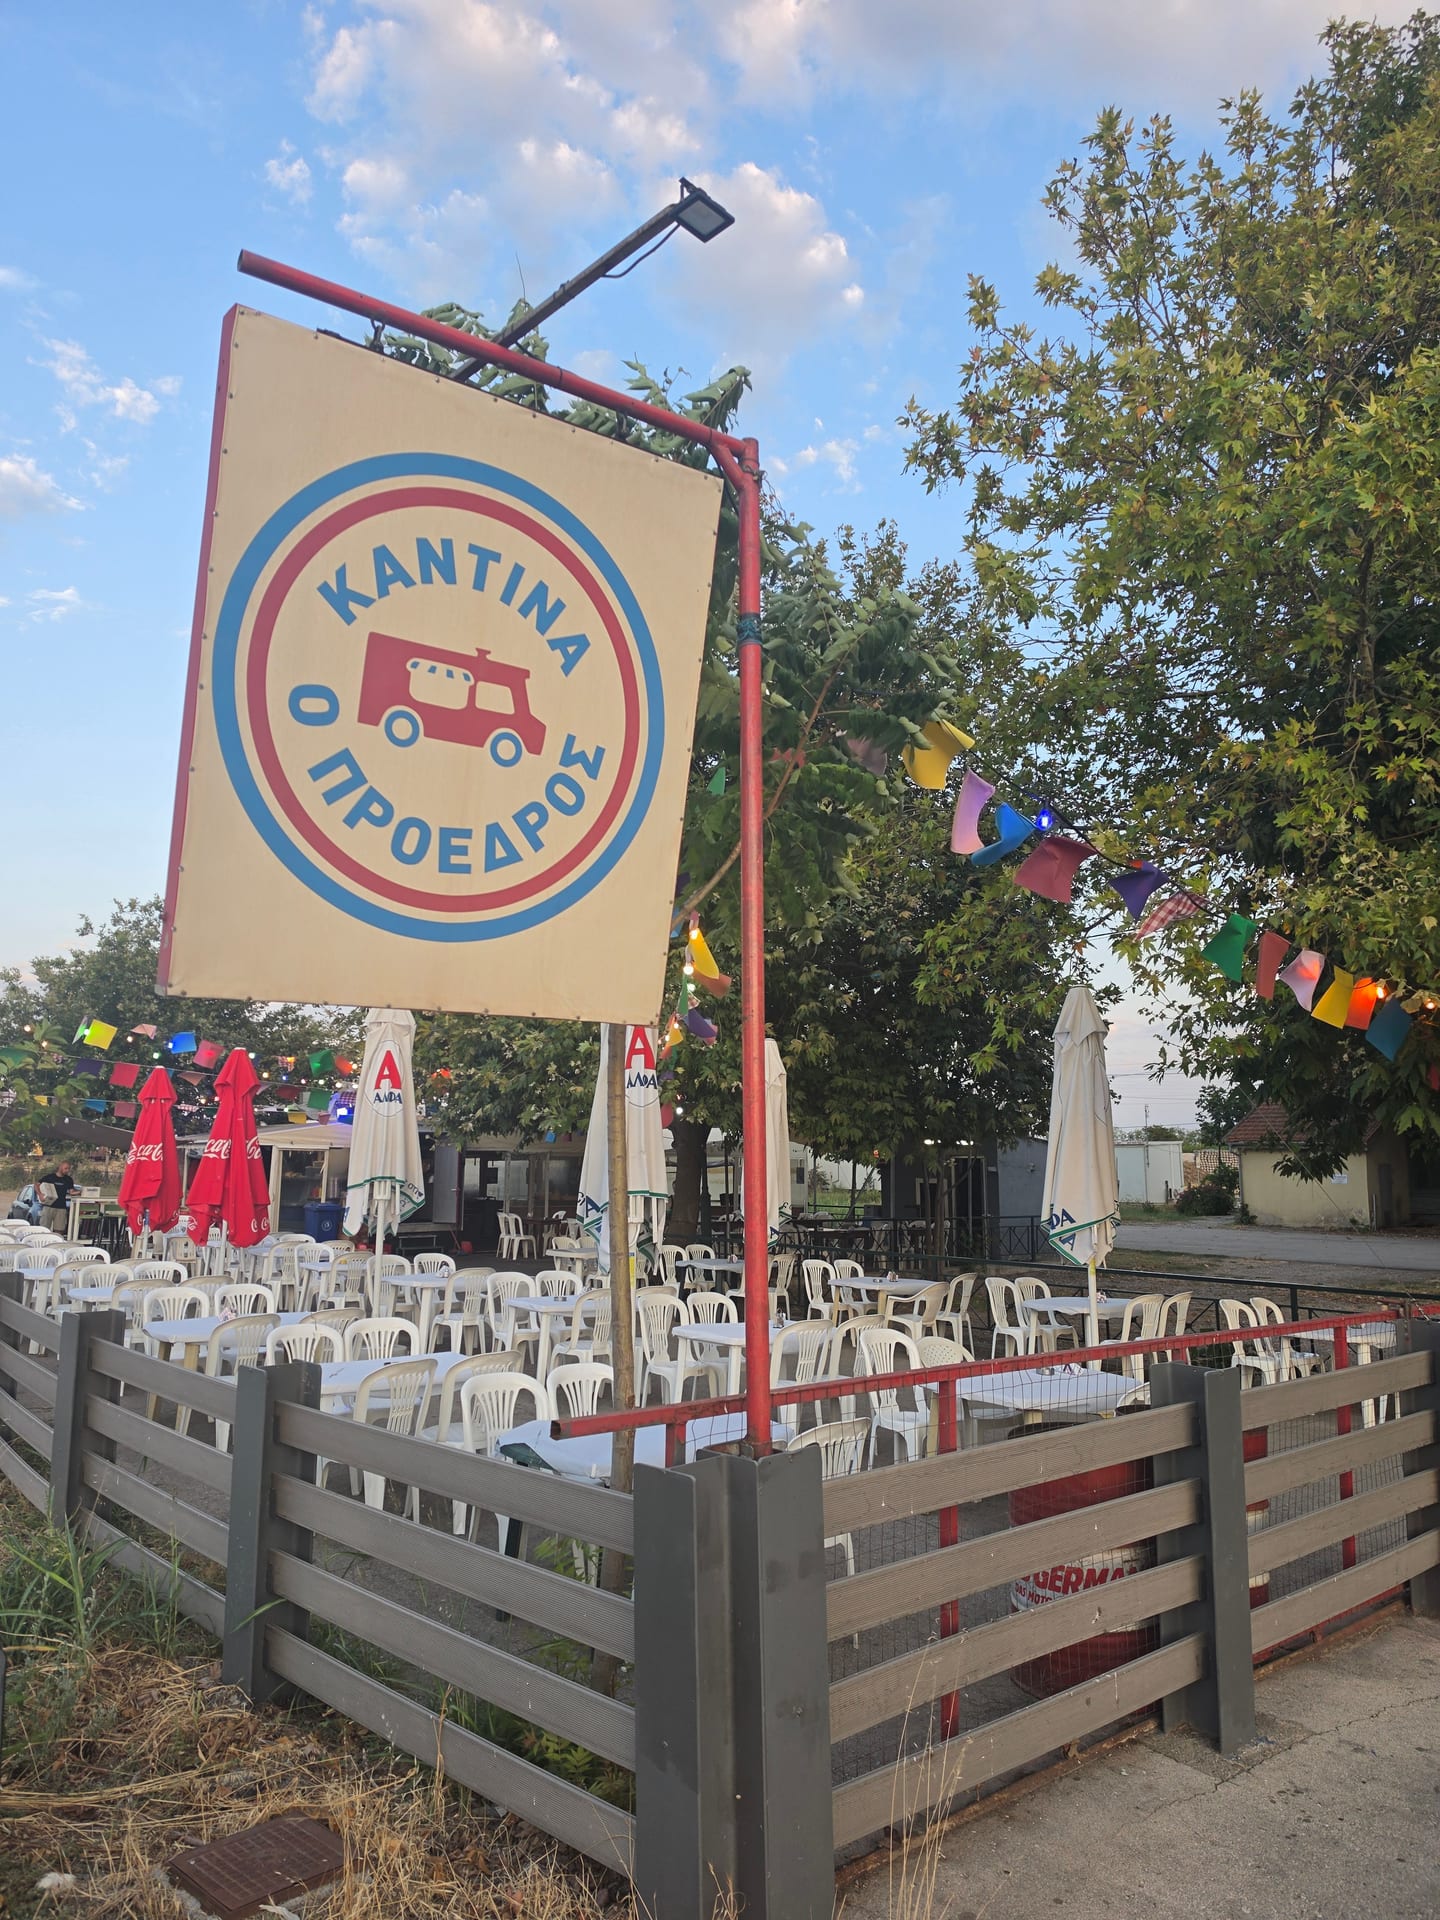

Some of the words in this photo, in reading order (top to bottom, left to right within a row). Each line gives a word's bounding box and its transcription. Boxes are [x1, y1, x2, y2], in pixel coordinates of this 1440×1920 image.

[316, 537, 592, 677] ΚΑΝΤΙΝΑ
[288, 684, 340, 726] Ο
[307, 733, 606, 874] ΠΡΟΕΔΡΟΣ
